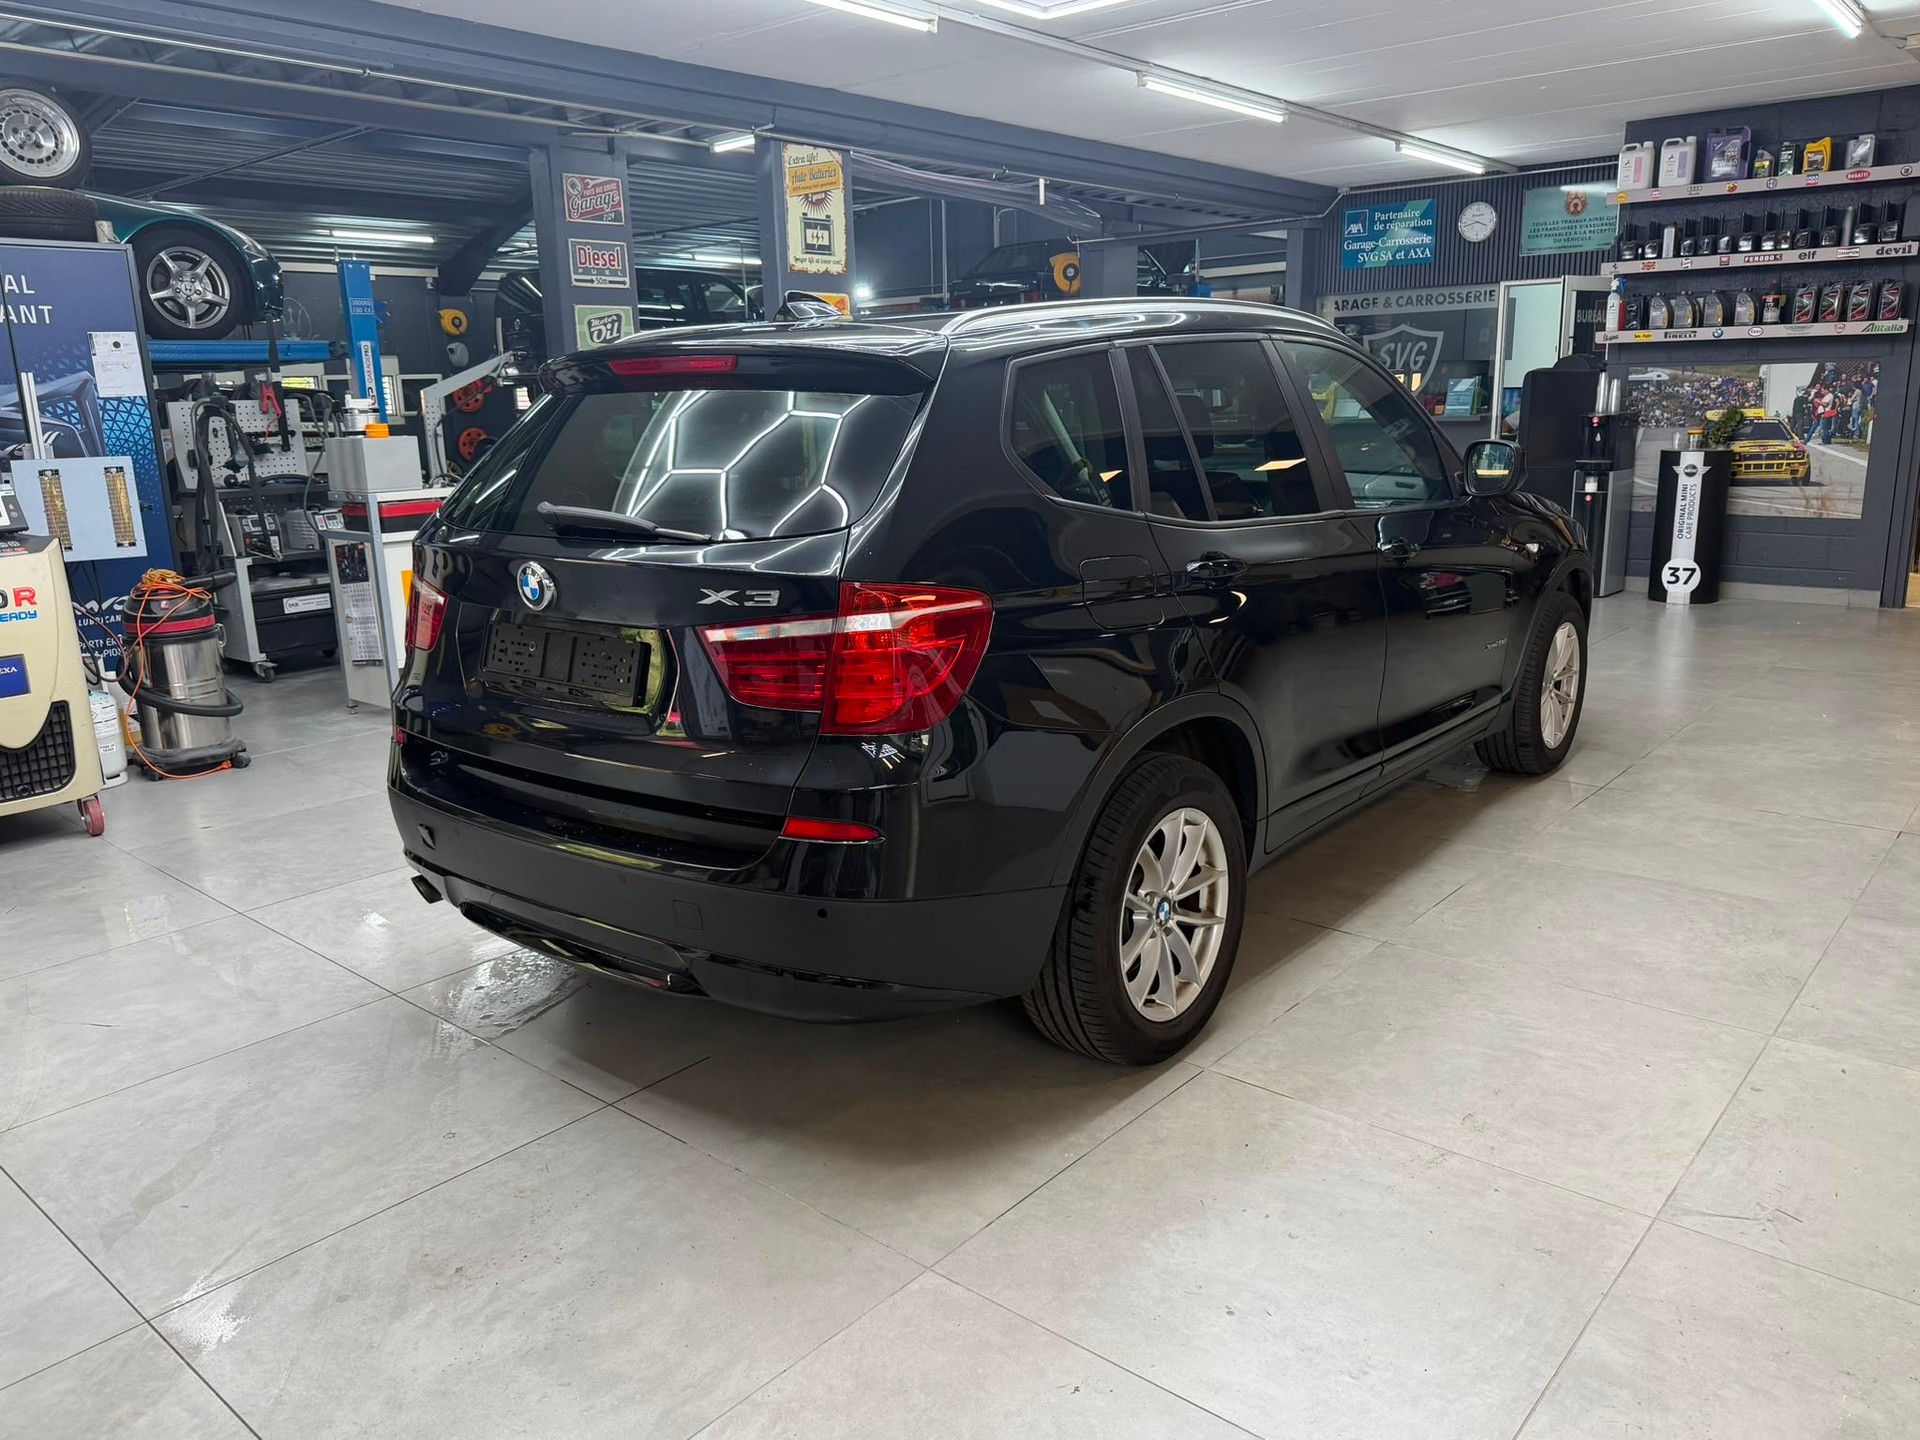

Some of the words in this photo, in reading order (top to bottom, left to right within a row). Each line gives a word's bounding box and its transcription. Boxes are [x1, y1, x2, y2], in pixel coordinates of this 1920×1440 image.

[788, 156, 806, 166] Extra
[806, 152, 818, 165] life!
[808, 166, 836, 180] Batteries
[570, 190, 620, 218] Garage
[1374, 208, 1420, 221] Partenaire
[1346, 223, 1364, 236] AXA
[1374, 221, 1384, 230] de
[1386, 218, 1432, 231] réparation
[1530, 226, 1541, 234] LES
[1542, 223, 1578, 232] FRANCHISES
[1532, 220, 1547, 228] TOUS
[1561, 217, 1586, 225] TRAVAUX
[1528, 232, 1542, 240] SONT
[1544, 230, 1572, 238] PAYABLES
[1344, 234, 1432, 252] Garage-Carrosserie
[1876, 244, 1912, 256] devil
[576, 245, 622, 270] Diesel
[1358, 252, 1378, 263] SVG
[1380, 250, 1393, 260] SA
[1396, 251, 1404, 260] et
[1408, 247, 1432, 258] AXA
[1744, 254, 1775, 263] FERODO
[1798, 251, 1816, 260] elf
[4, 274, 35, 294] AL
[1383, 296, 1393, 308] &
[1396, 289, 1496, 308] CARROSSERIE
[591, 322, 620, 342] Oil
[1664, 330, 1698, 338] PIRELLI
[1861, 322, 1904, 332] Alitalia
[1379, 341, 1428, 371] SVG
[1680, 484, 1688, 501] MINI
[1686, 483, 1697, 520] PRODUCTS
[1677, 504, 1687, 539] ORIGINAL
[1666, 566, 1697, 585] 37
[697, 588, 779, 607] X3
